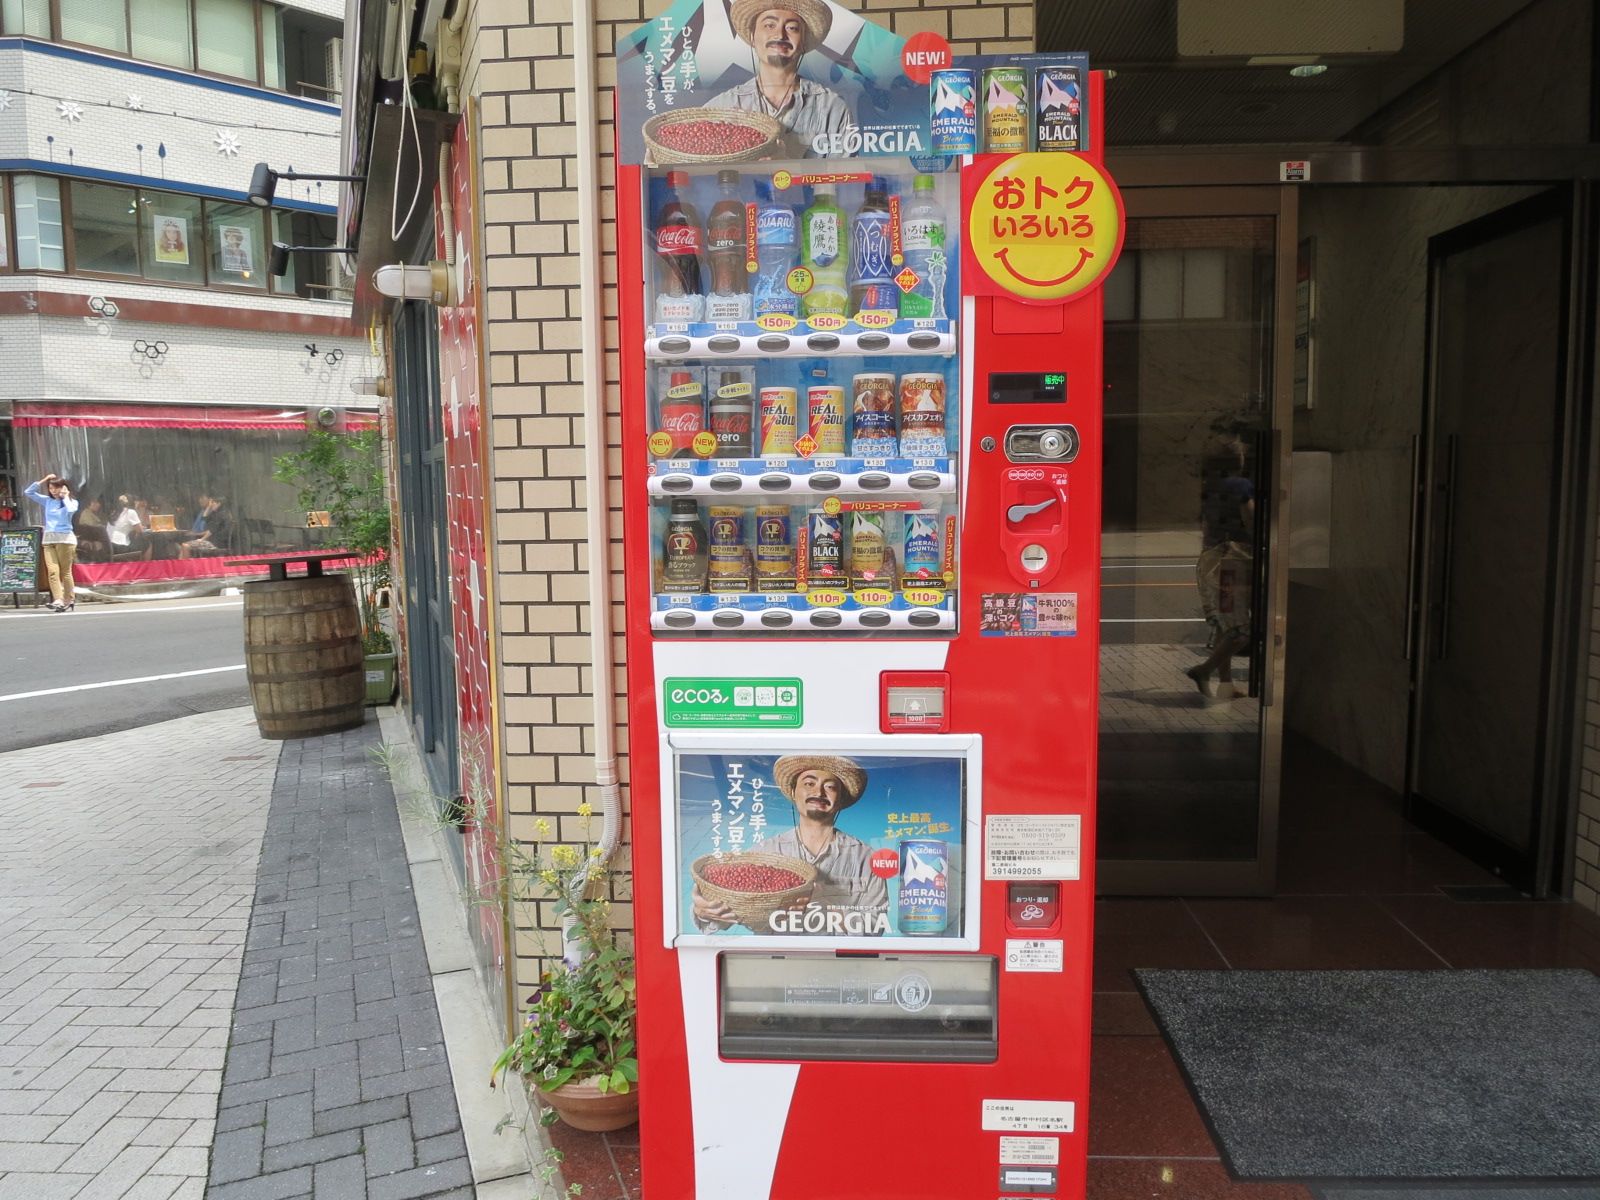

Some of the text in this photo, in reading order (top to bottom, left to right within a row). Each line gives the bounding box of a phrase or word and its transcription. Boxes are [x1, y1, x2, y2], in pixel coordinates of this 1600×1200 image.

[658, 16, 677, 105] エメマン豆を
[680, 26, 696, 94] ひとの手が、
[905, 51, 945, 66] NEW!
[997, 74, 1024, 82] GEORGIA
[1050, 71, 1076, 81] GEORGIA
[645, 51, 657, 114] うまくする。
[932, 117, 974, 130] EMERALD
[1039, 124, 1078, 141] BLACK
[812, 126, 922, 155] GEORGIA
[801, 174, 859, 184] バリューコーナー
[993, 176, 1094, 209] おトク
[890, 200, 899, 252] バリュープライス
[904, 224, 937, 234] いろはす
[993, 215, 1094, 238] いろいろ
[747, 208, 756, 259] バリュープライス
[716, 239, 734, 247] zero
[763, 317, 791, 328] 150円
[813, 317, 841, 327] 150円
[860, 314, 889, 325] 150円
[763, 403, 788, 415] REAL
[811, 403, 838, 415] REAL
[775, 415, 796, 426] GOLD
[824, 414, 844, 425] GOLD
[855, 413, 894, 422] アイスコーヒー
[902, 413, 944, 422] アイスカフェオレ
[695, 438, 715, 446] NEW
[716, 433, 740, 442] zero
[851, 502, 907, 510] バリューコーナー
[946, 519, 954, 569] バリュープライス
[799, 531, 807, 580] バリュープライス
[812, 546, 839, 557] BLACK
[813, 593, 840, 603] 110円
[861, 592, 887, 602] 110円
[911, 592, 938, 602] 110円
[1038, 599, 1075, 608] 牛乳100%
[984, 613, 1016, 622] 深いコク
[727, 763, 745, 856] エメマン豆を
[915, 846, 942, 855] GEORGIA
[872, 859, 898, 869] NEW!
[992, 867, 1043, 875] 3914992055
[900, 888, 946, 898] EMERALD
[768, 903, 893, 934] GEORGIA
